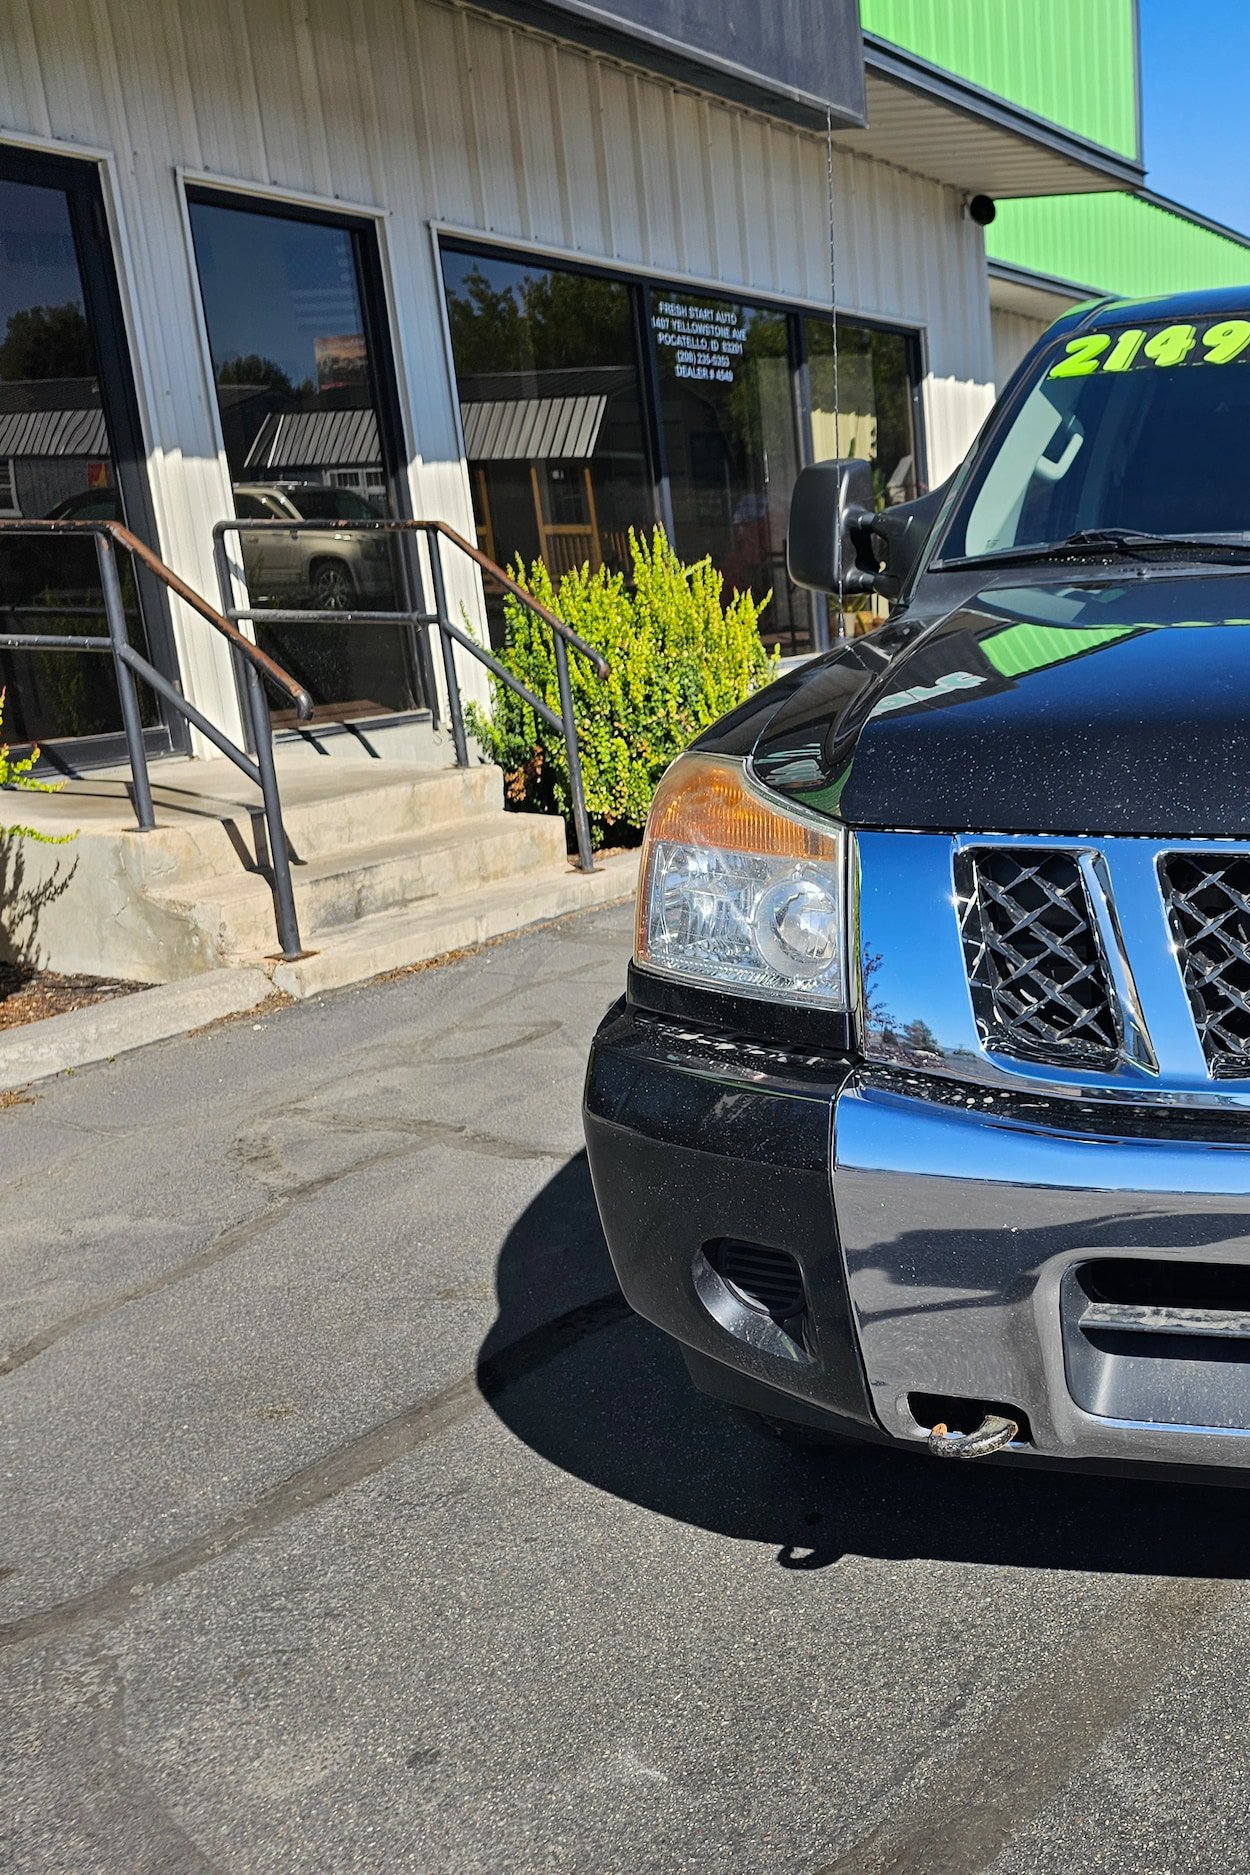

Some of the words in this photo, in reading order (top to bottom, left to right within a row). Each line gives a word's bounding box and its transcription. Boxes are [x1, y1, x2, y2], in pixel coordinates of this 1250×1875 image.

[659, 301, 688, 317] FRESH
[689, 306, 714, 321] START
[716, 310, 737, 326] AUTO
[671, 318, 730, 339] YELLOWSTONE
[732, 328, 747, 341] AVE
[711, 339, 719, 352] ID
[675, 363, 708, 379] DEALER
